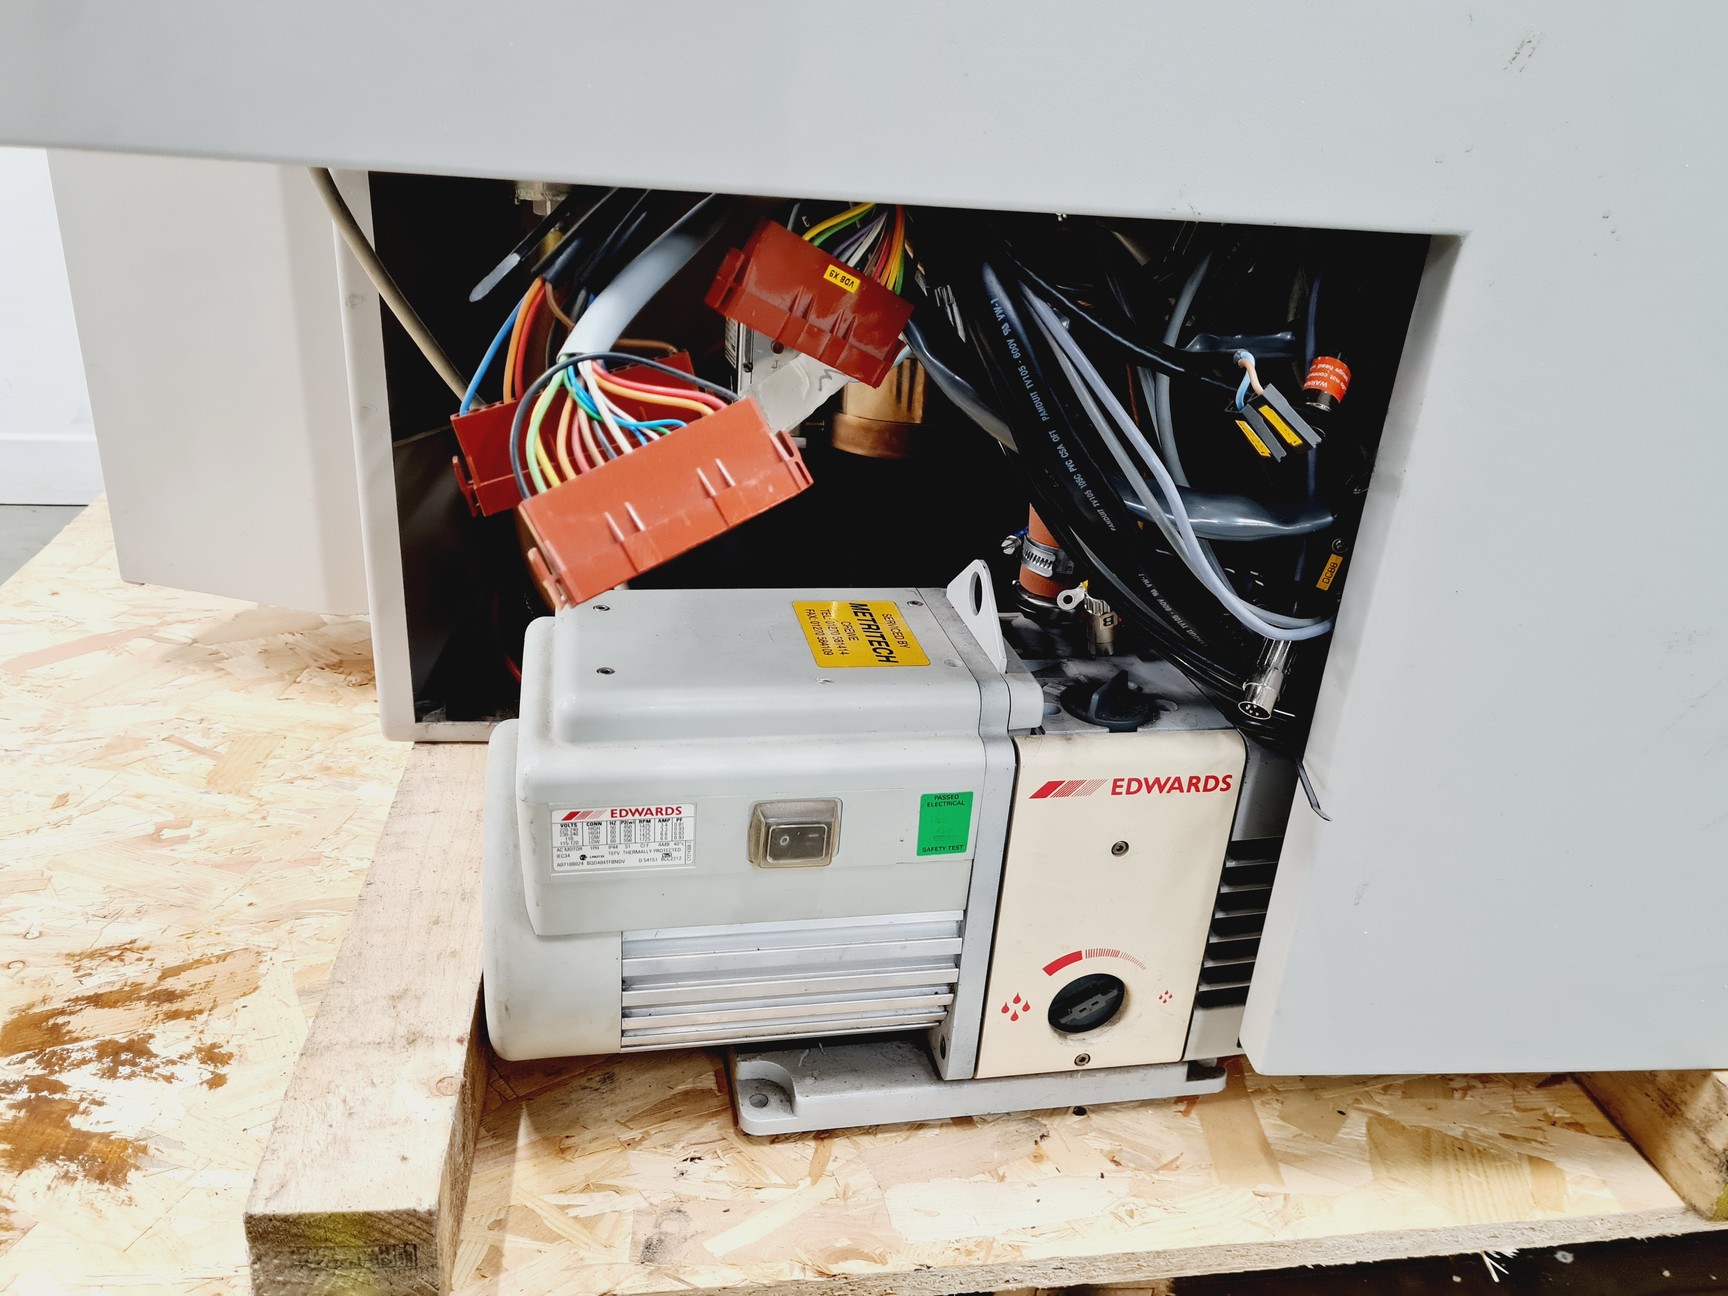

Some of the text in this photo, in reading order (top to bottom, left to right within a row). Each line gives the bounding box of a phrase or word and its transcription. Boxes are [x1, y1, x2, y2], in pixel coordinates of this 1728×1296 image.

[829, 270, 855, 288] VDB X9
[990, 298, 1006, 321] VW-1
[1006, 339, 1021, 359] 600V
[1018, 365, 1034, 389] TV105
[1030, 391, 1050, 421] PANDUIT
[1056, 443, 1069, 459] CSA
[1065, 460, 1077, 473] PVC
[849, 602, 899, 664] METRITECH
[882, 613, 911, 649] SERVICED BY
[1111, 775, 1233, 796] EDWARDS
[610, 806, 682, 818] EDWARDS
